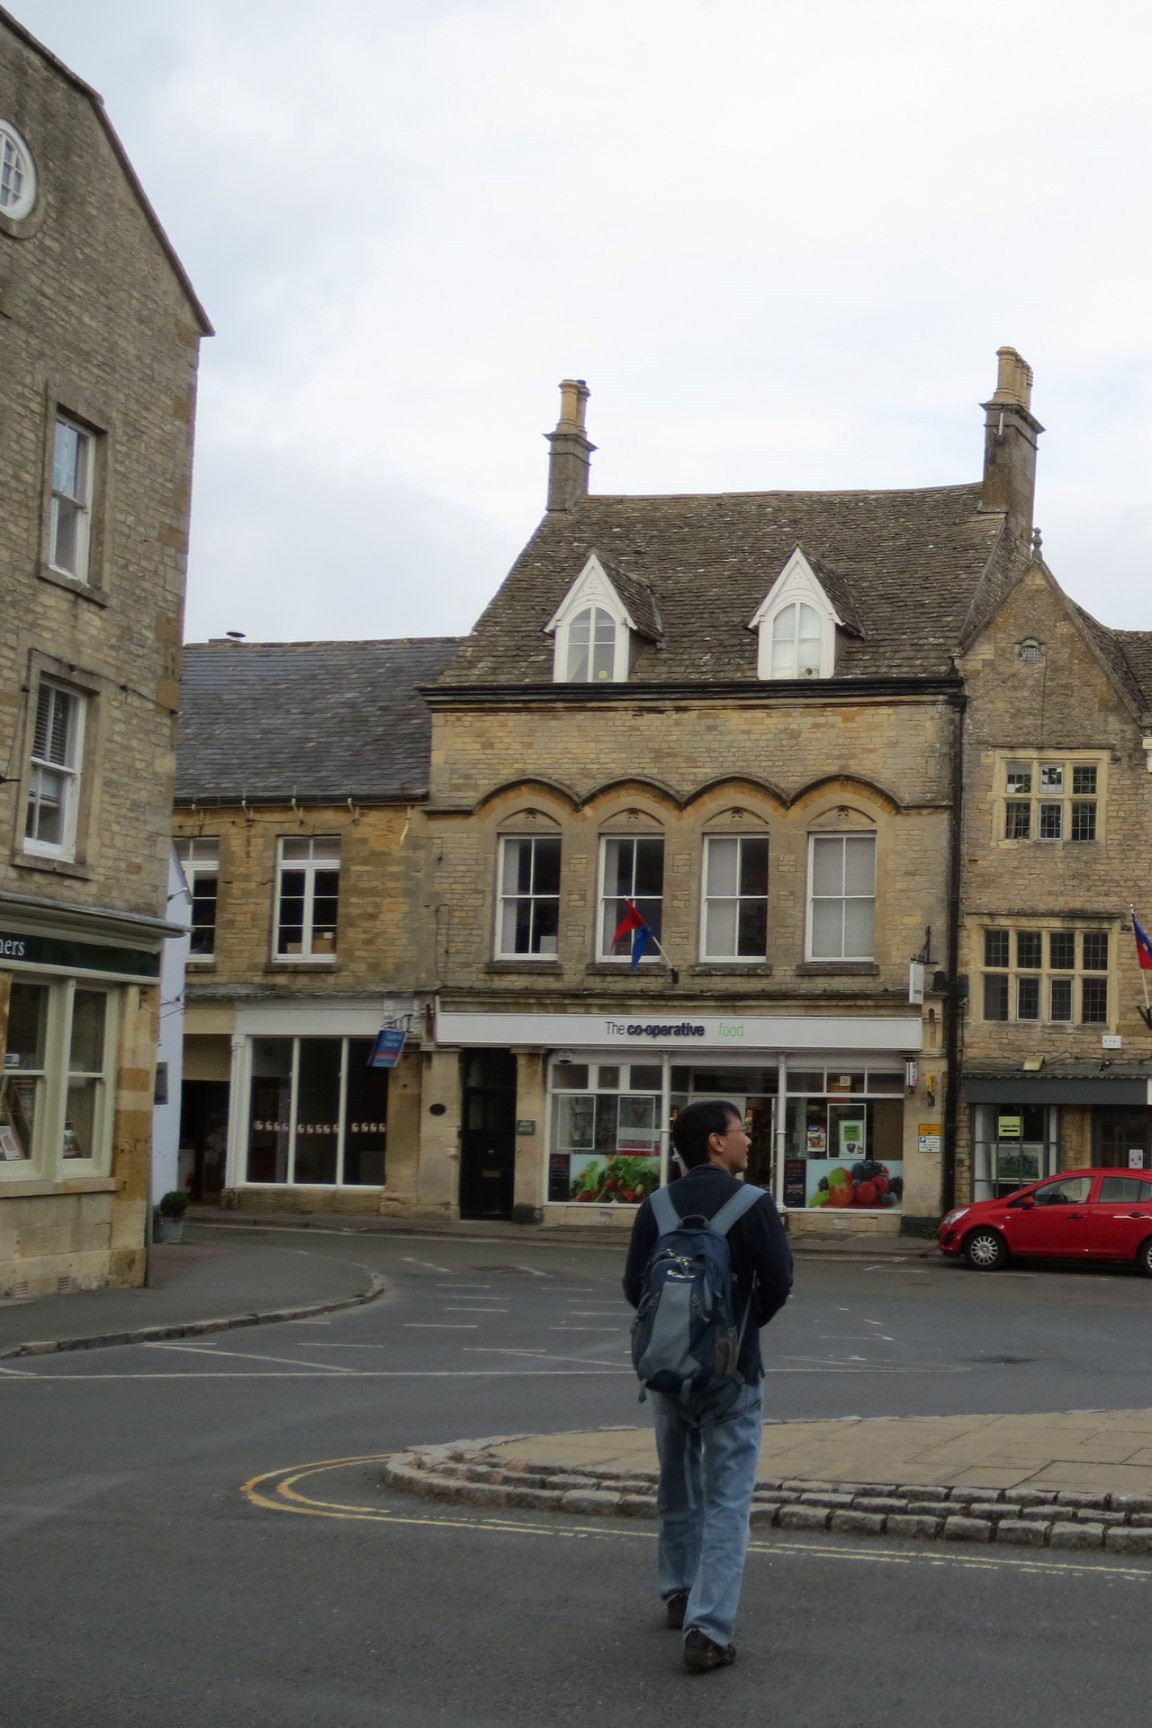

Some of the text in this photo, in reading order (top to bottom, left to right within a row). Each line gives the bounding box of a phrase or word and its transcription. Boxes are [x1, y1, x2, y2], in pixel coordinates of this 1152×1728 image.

[605, 1021, 745, 1038] The co-operative food
